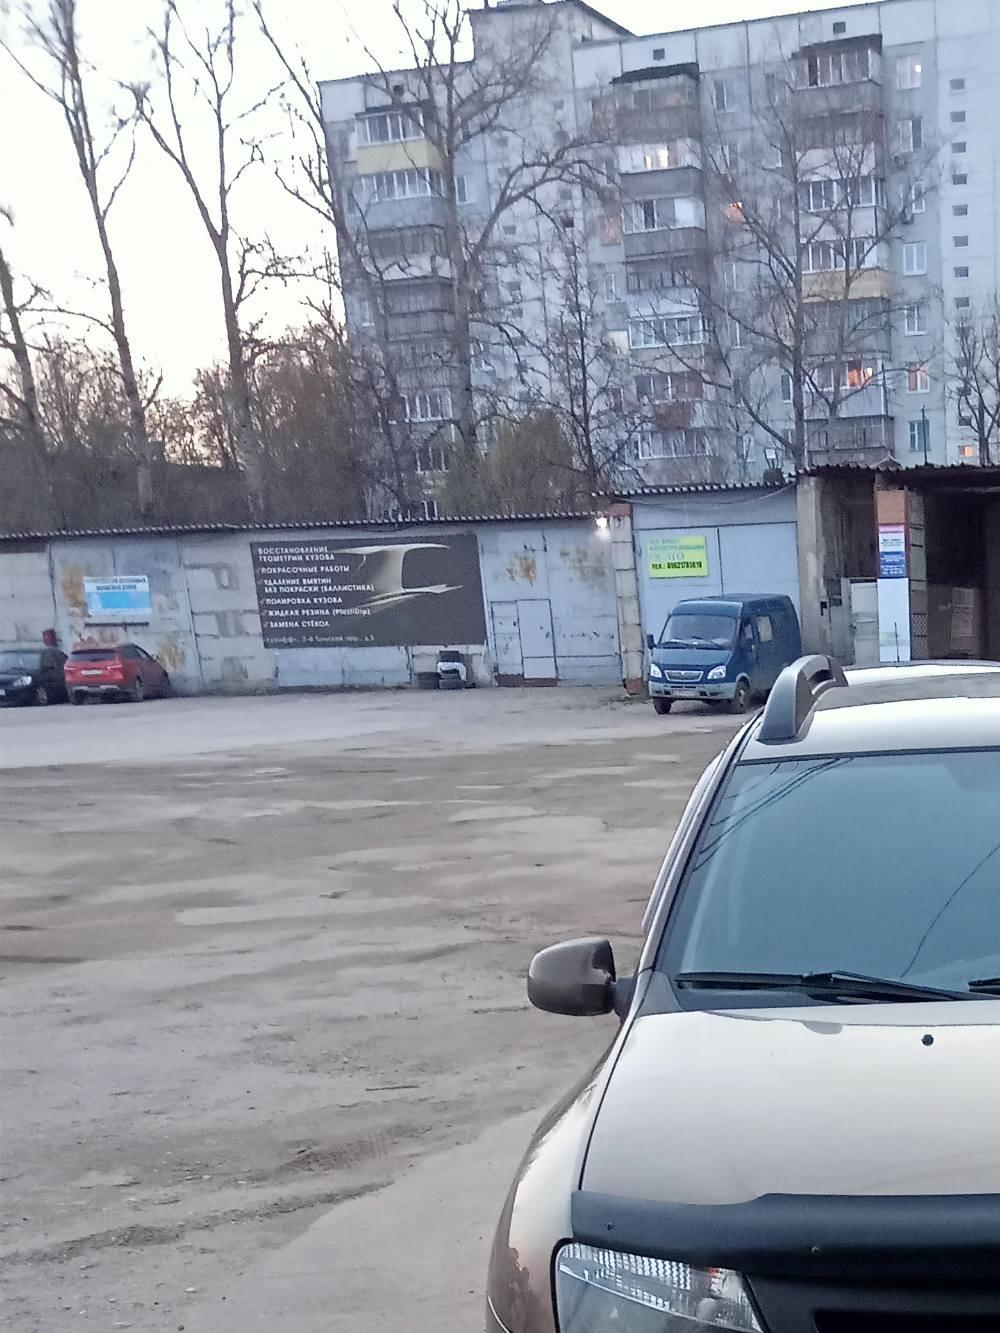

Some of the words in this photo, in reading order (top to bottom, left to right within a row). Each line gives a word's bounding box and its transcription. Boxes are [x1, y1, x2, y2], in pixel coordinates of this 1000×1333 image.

[258, 546, 328, 554] ВОССТАНОВЛЕНИЕ
[261, 566, 317, 574] ПОКРАСОЧНЫЕ
[279, 585, 319, 593] ПОКРАСКИ
[321, 584, 374, 592] (БАЛЛИСТИКА)
[268, 609, 299, 617] ЖИДКАЯ
